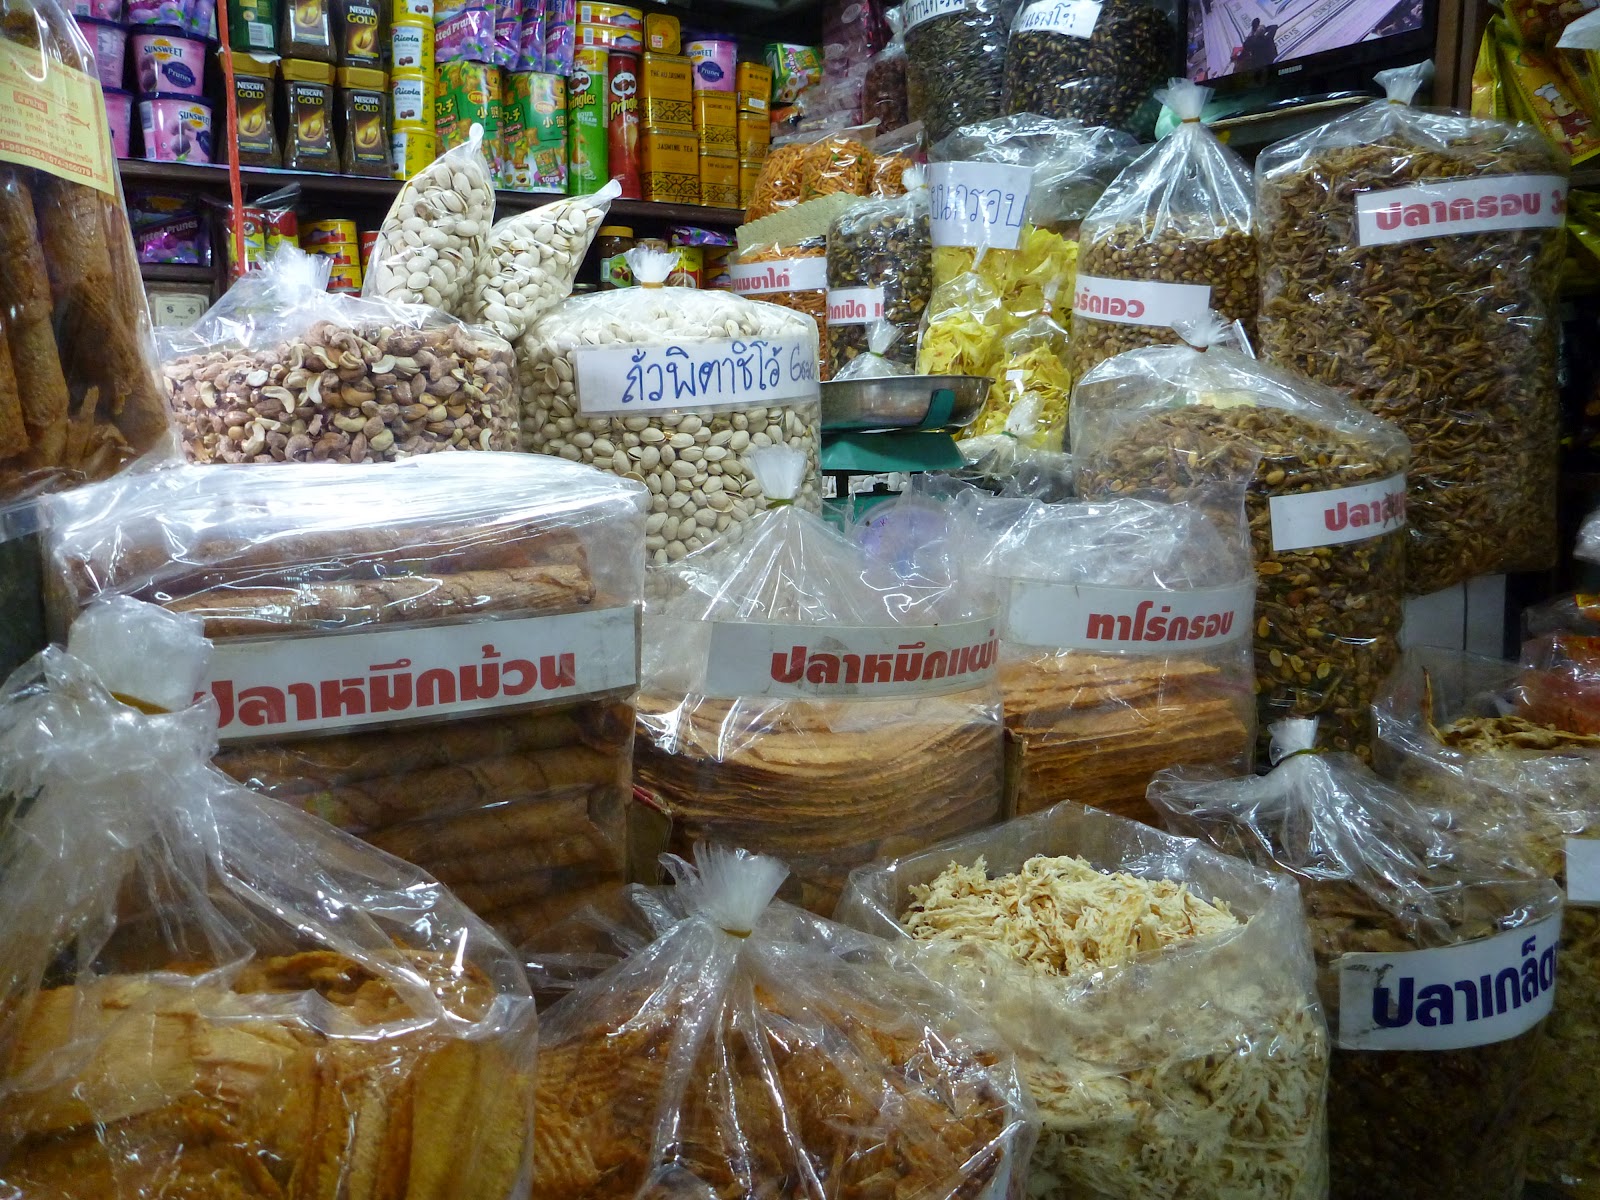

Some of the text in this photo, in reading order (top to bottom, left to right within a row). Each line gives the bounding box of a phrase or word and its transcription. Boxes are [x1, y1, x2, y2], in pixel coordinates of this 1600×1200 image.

[347, 13, 377, 26] GOLD
[394, 34, 419, 42] Ricola
[144, 45, 183, 57] SUNSWEET
[167, 68, 192, 83] Prunes
[701, 69, 720, 78] Prunes
[237, 89, 264, 99] GOLD
[394, 87, 421, 96] Ricola
[297, 95, 323, 105] GOLD
[354, 103, 378, 113] GOLD
[657, 143, 693, 153] JASMINE TEA
[1376, 192, 1541, 231] ปลากรอบ
[166, 220, 198, 234] Prunes
[1086, 600, 1235, 642] ทาโร่กรอบ
[192, 644, 576, 729] ปลาหมึกม้วน
